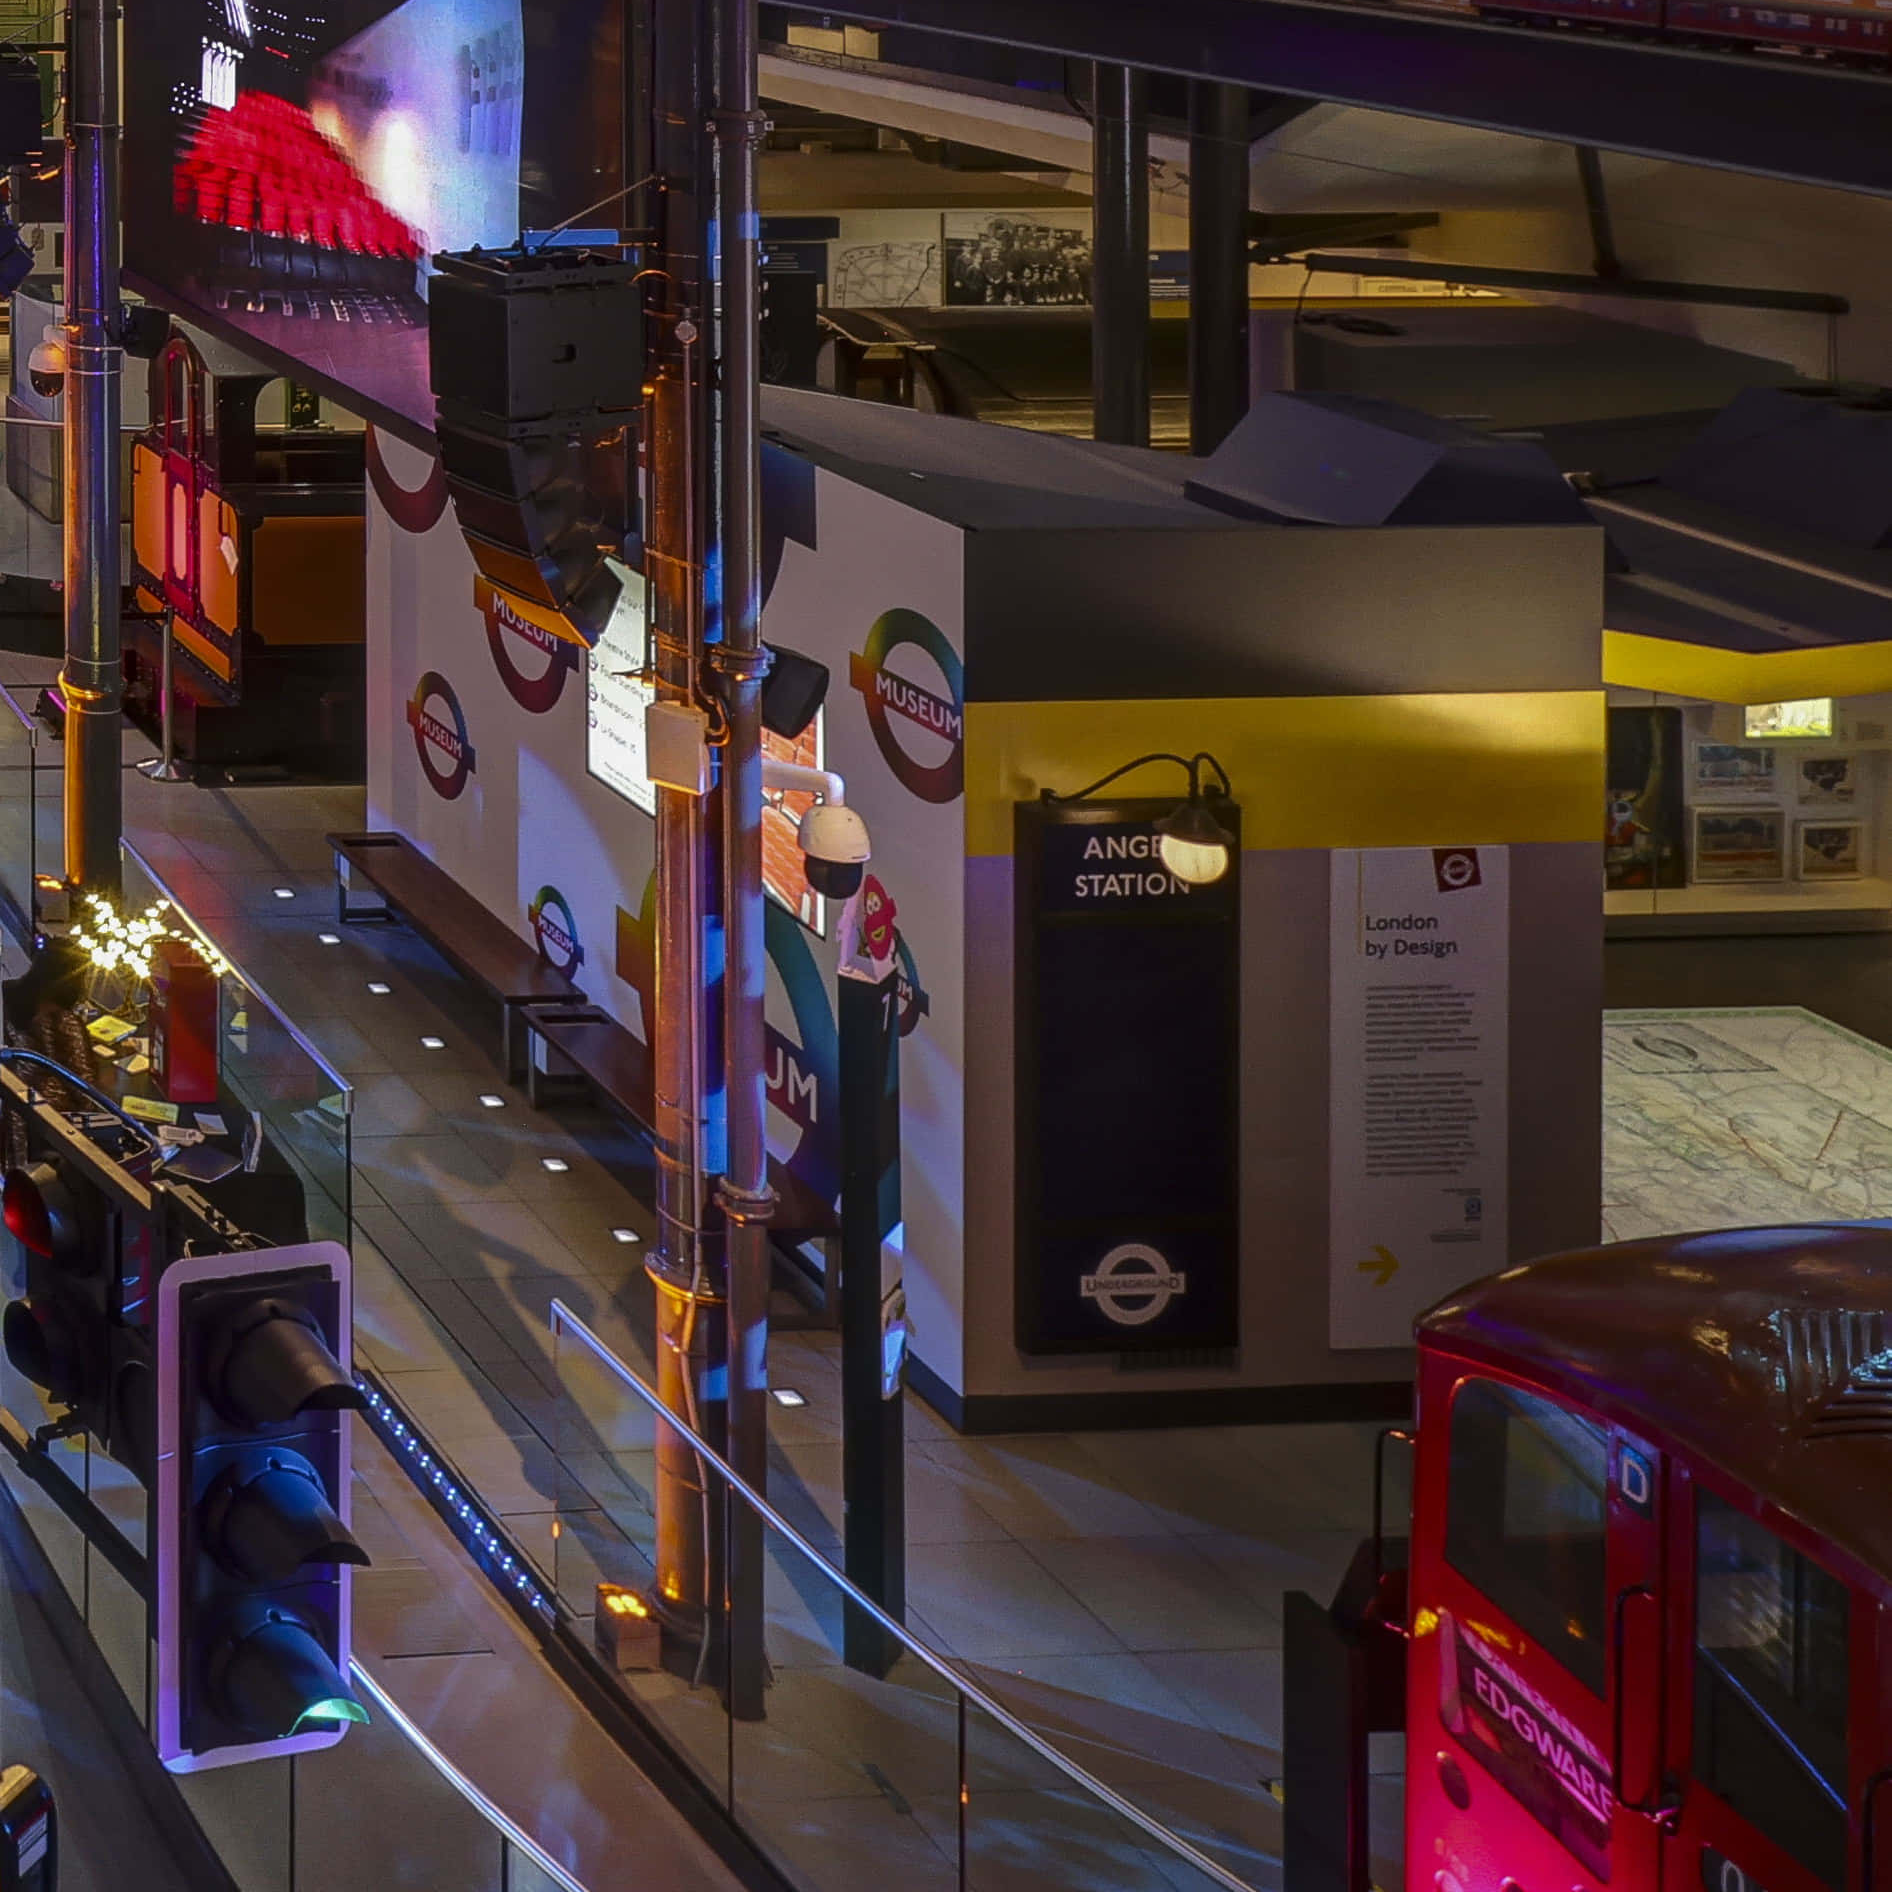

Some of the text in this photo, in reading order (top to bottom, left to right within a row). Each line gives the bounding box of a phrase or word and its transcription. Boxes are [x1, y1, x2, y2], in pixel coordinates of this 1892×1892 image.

[876, 672, 962, 739] MUSEUM
[419, 713, 463, 758] MUSEUM
[1083, 835, 1162, 860] ANGE
[1074, 873, 1190, 897] STATION
[1365, 914, 1439, 932] London
[1366, 938, 1459, 959] by Design
[1086, 1277, 1181, 1292] UNDERGROUND
[1621, 1458, 1648, 1504] D
[1474, 1667, 1614, 1816] EDGWARE
